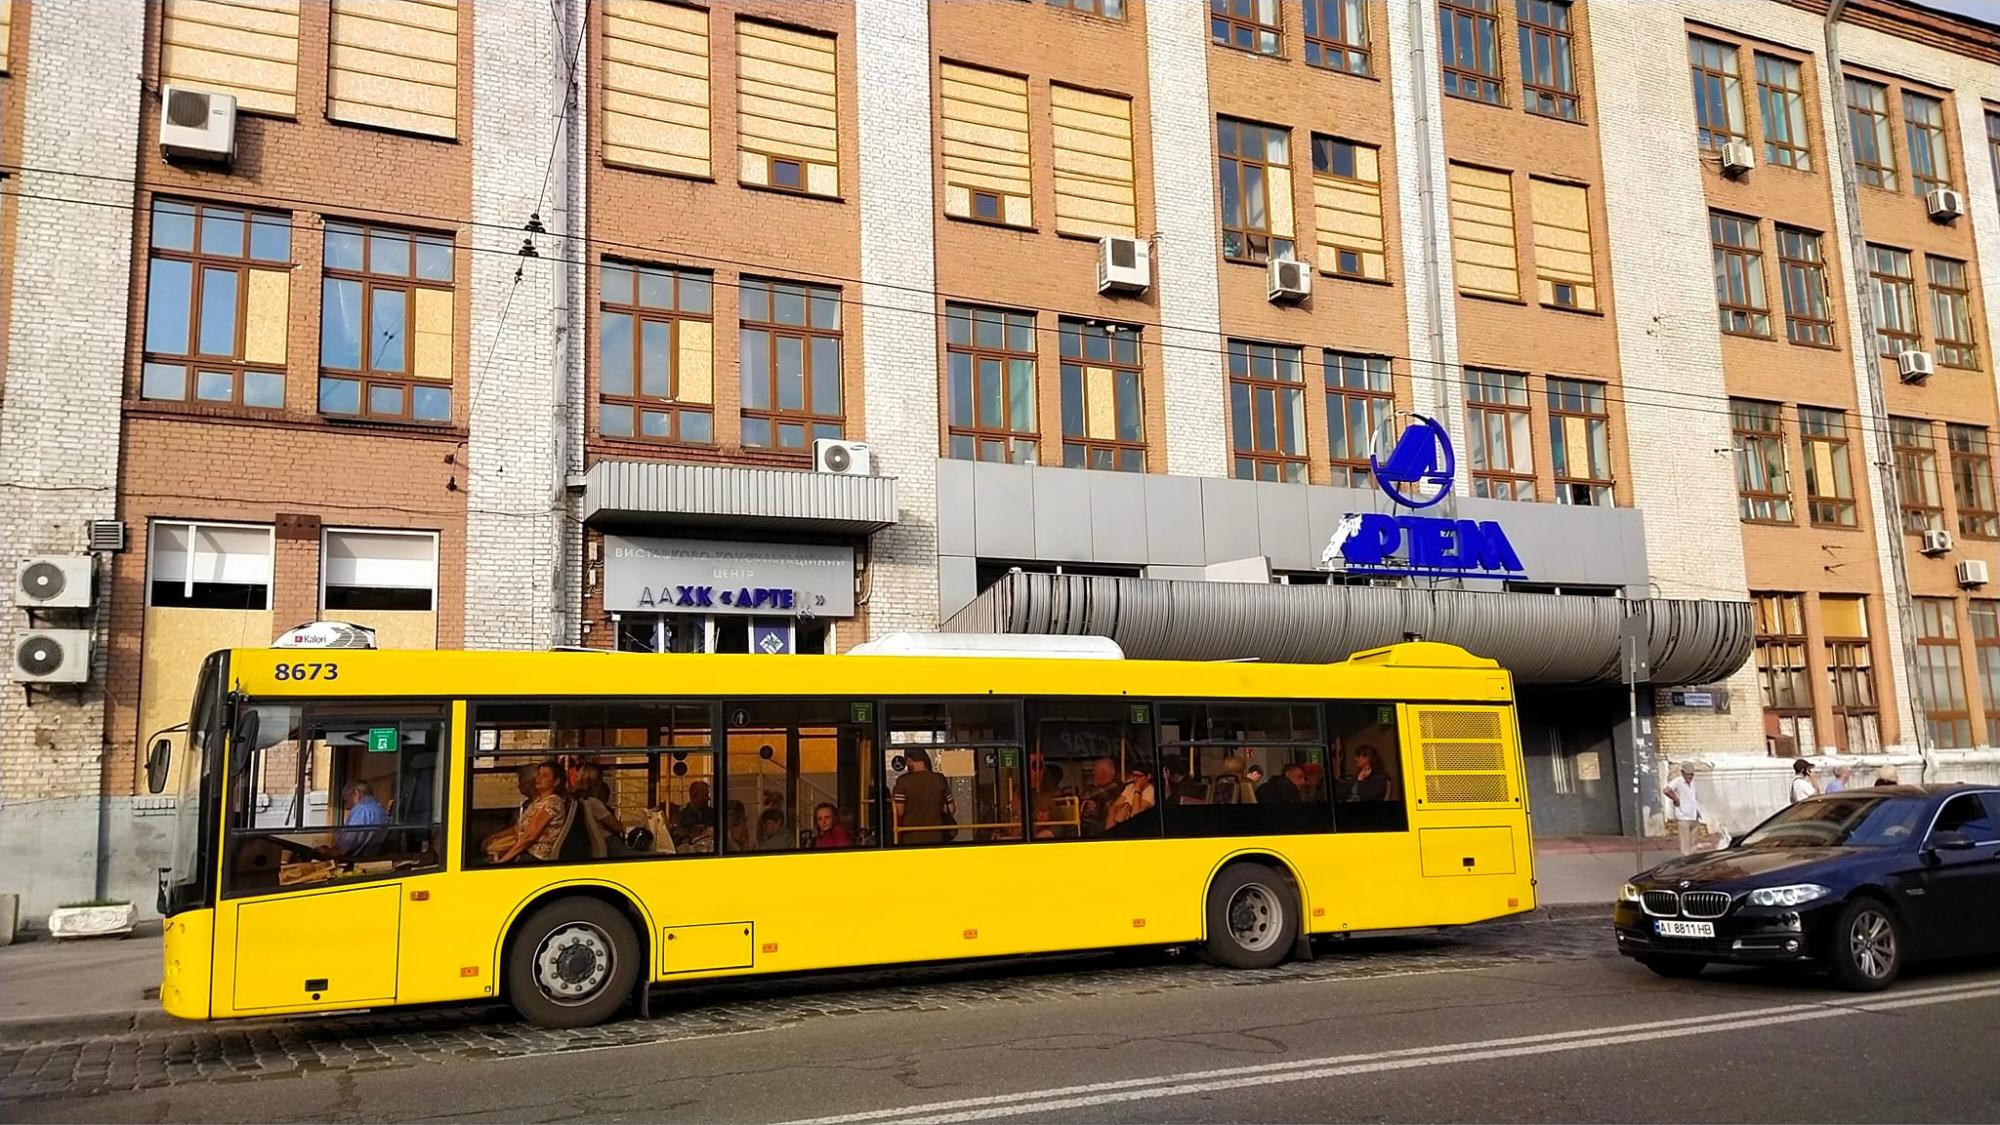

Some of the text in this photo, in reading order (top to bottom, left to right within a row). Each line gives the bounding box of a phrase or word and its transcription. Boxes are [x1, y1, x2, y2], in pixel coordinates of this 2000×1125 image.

[713, 568, 755, 580] ЦЕНТР
[275, 663, 338, 681] 8673
[1674, 923, 1697, 934] 8811
